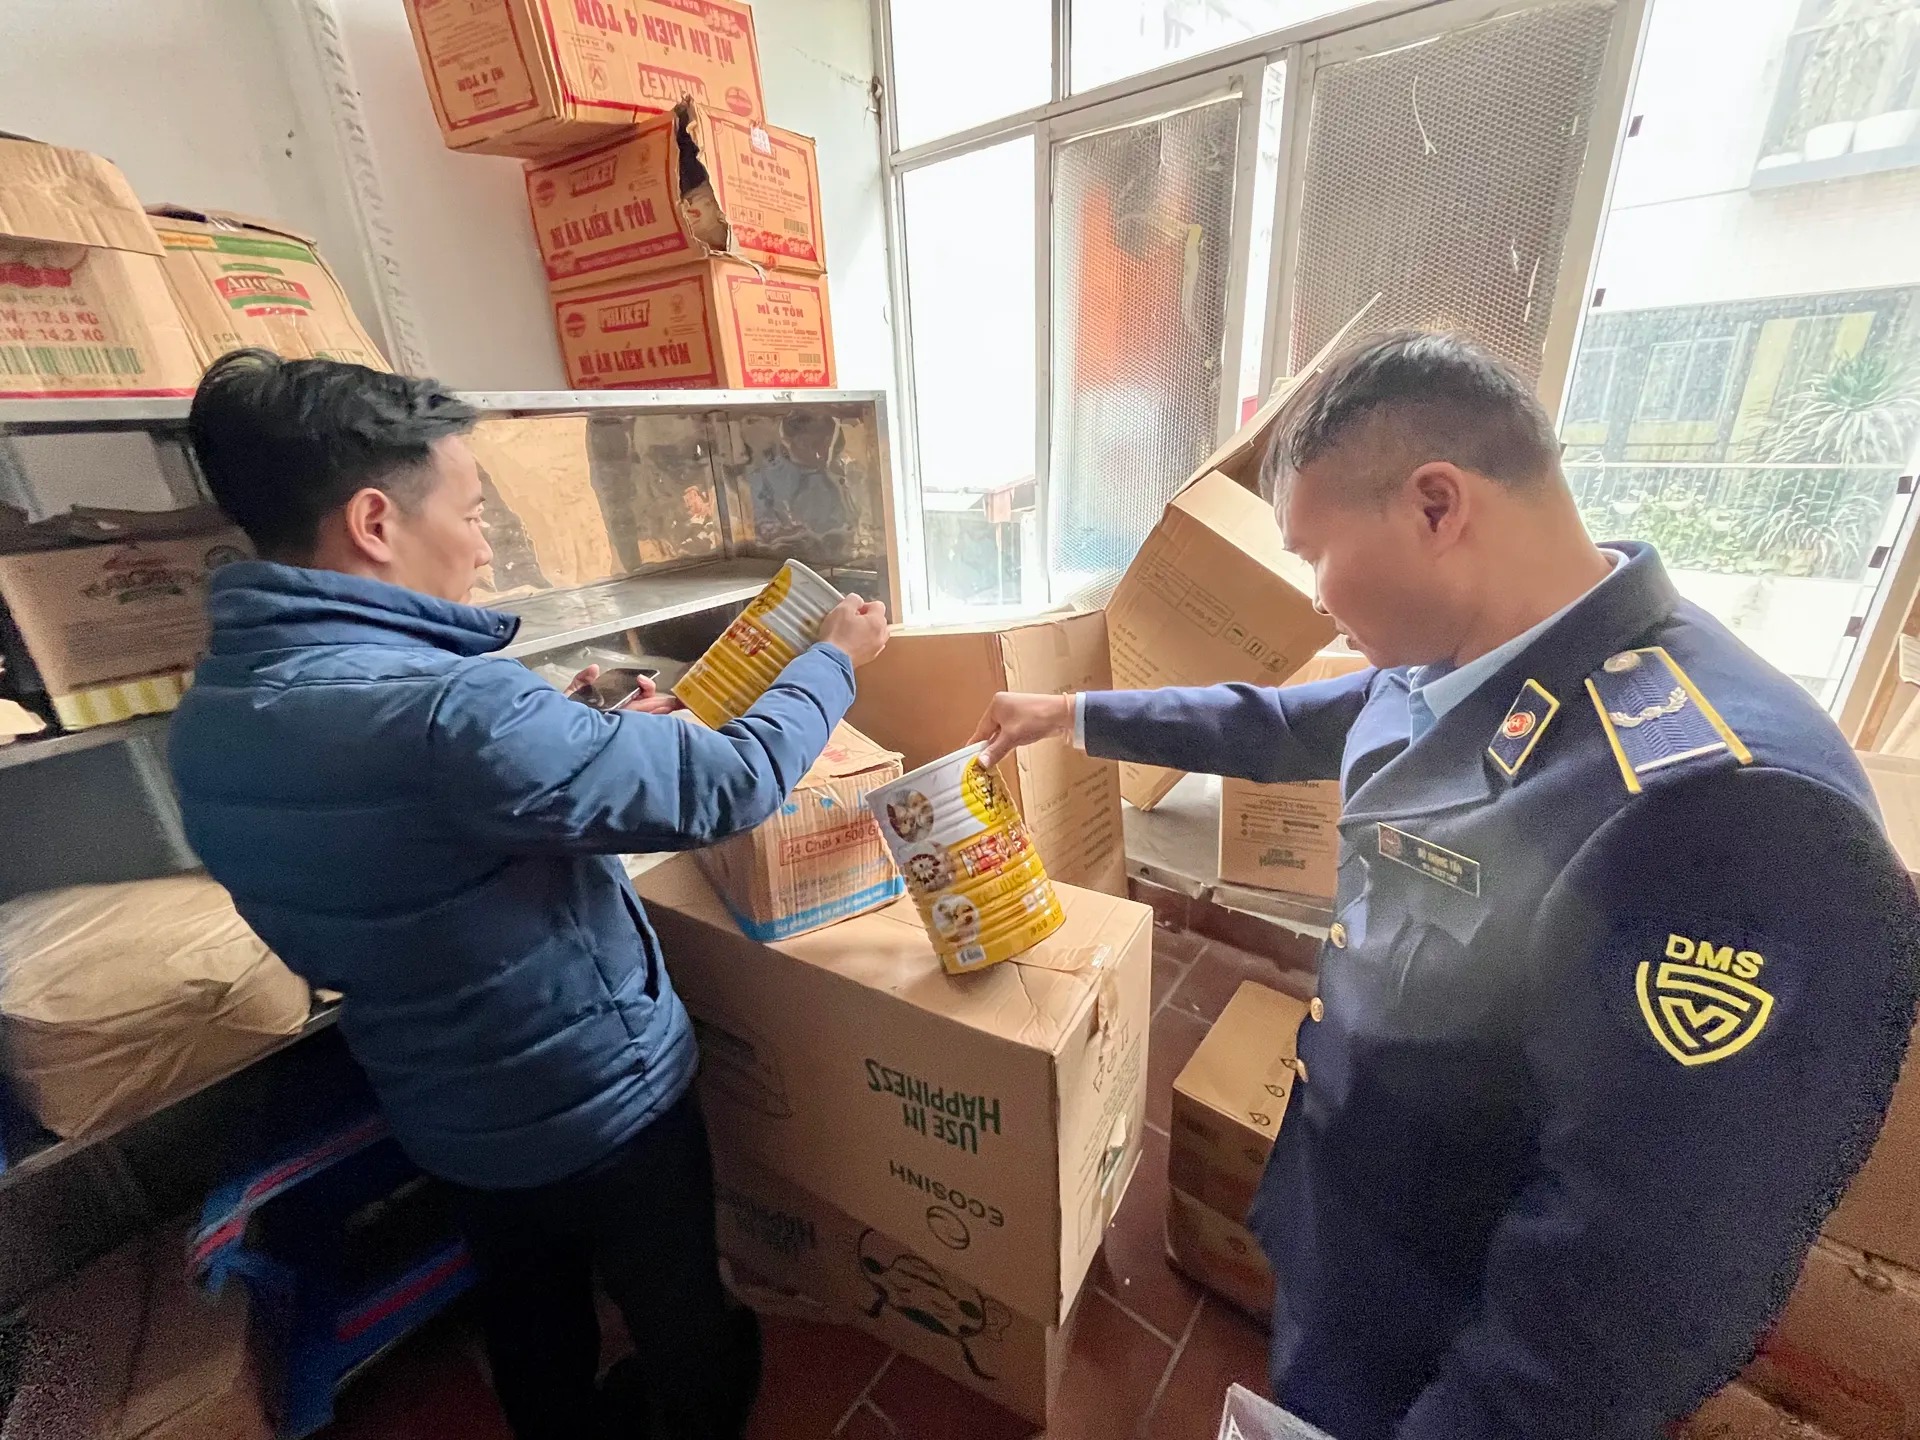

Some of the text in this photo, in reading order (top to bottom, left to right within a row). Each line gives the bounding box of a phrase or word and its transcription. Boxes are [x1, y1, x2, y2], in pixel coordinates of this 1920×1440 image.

[624, 8, 638, 38] 4
[613, 207, 624, 232] 4
[773, 305, 781, 316] 4
[647, 347, 657, 368] 4
[1665, 932, 1764, 979] DMS
[864, 1058, 1001, 1136] HAPPINESS
[902, 1102, 978, 1155] USE IN
[889, 1159, 1005, 1228] ECOSINH
